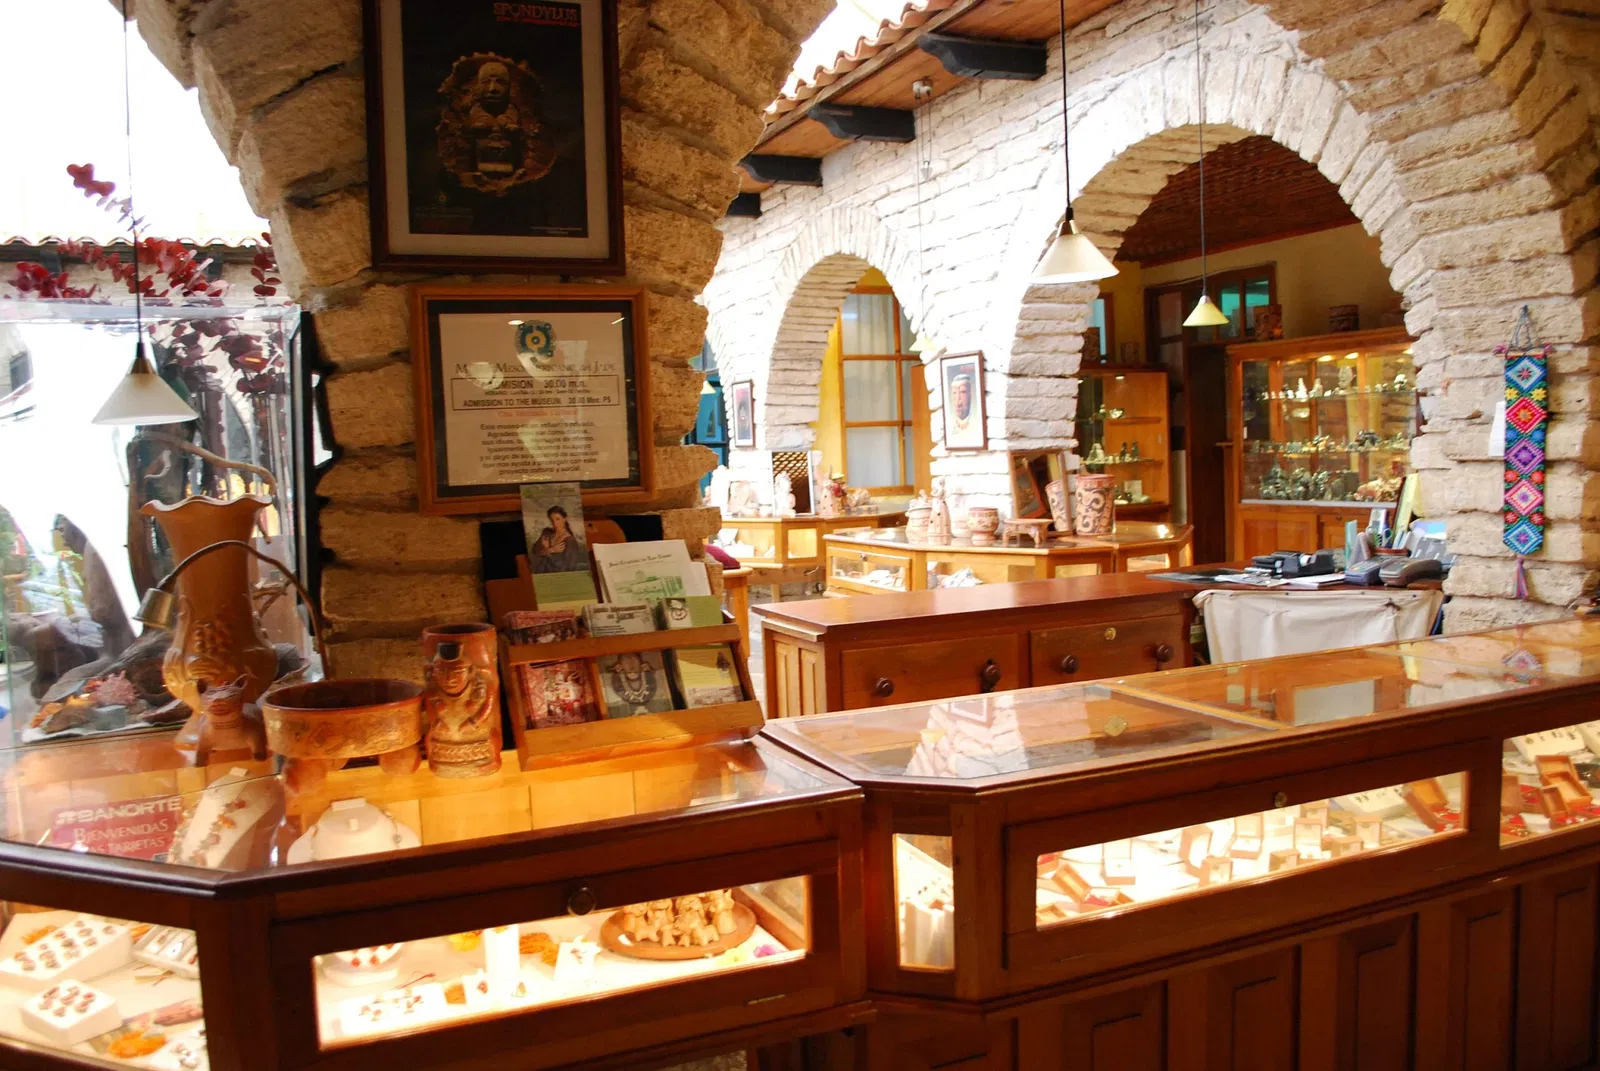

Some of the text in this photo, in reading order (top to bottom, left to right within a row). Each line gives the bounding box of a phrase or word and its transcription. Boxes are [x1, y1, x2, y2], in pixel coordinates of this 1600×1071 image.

[493, 2, 577, 20] SPONDYLUS
[462, 399, 503, 408] ADMISSION
[504, 398, 515, 406] TO
[516, 398, 530, 406] THE
[78, 796, 182, 823] BANORTE
